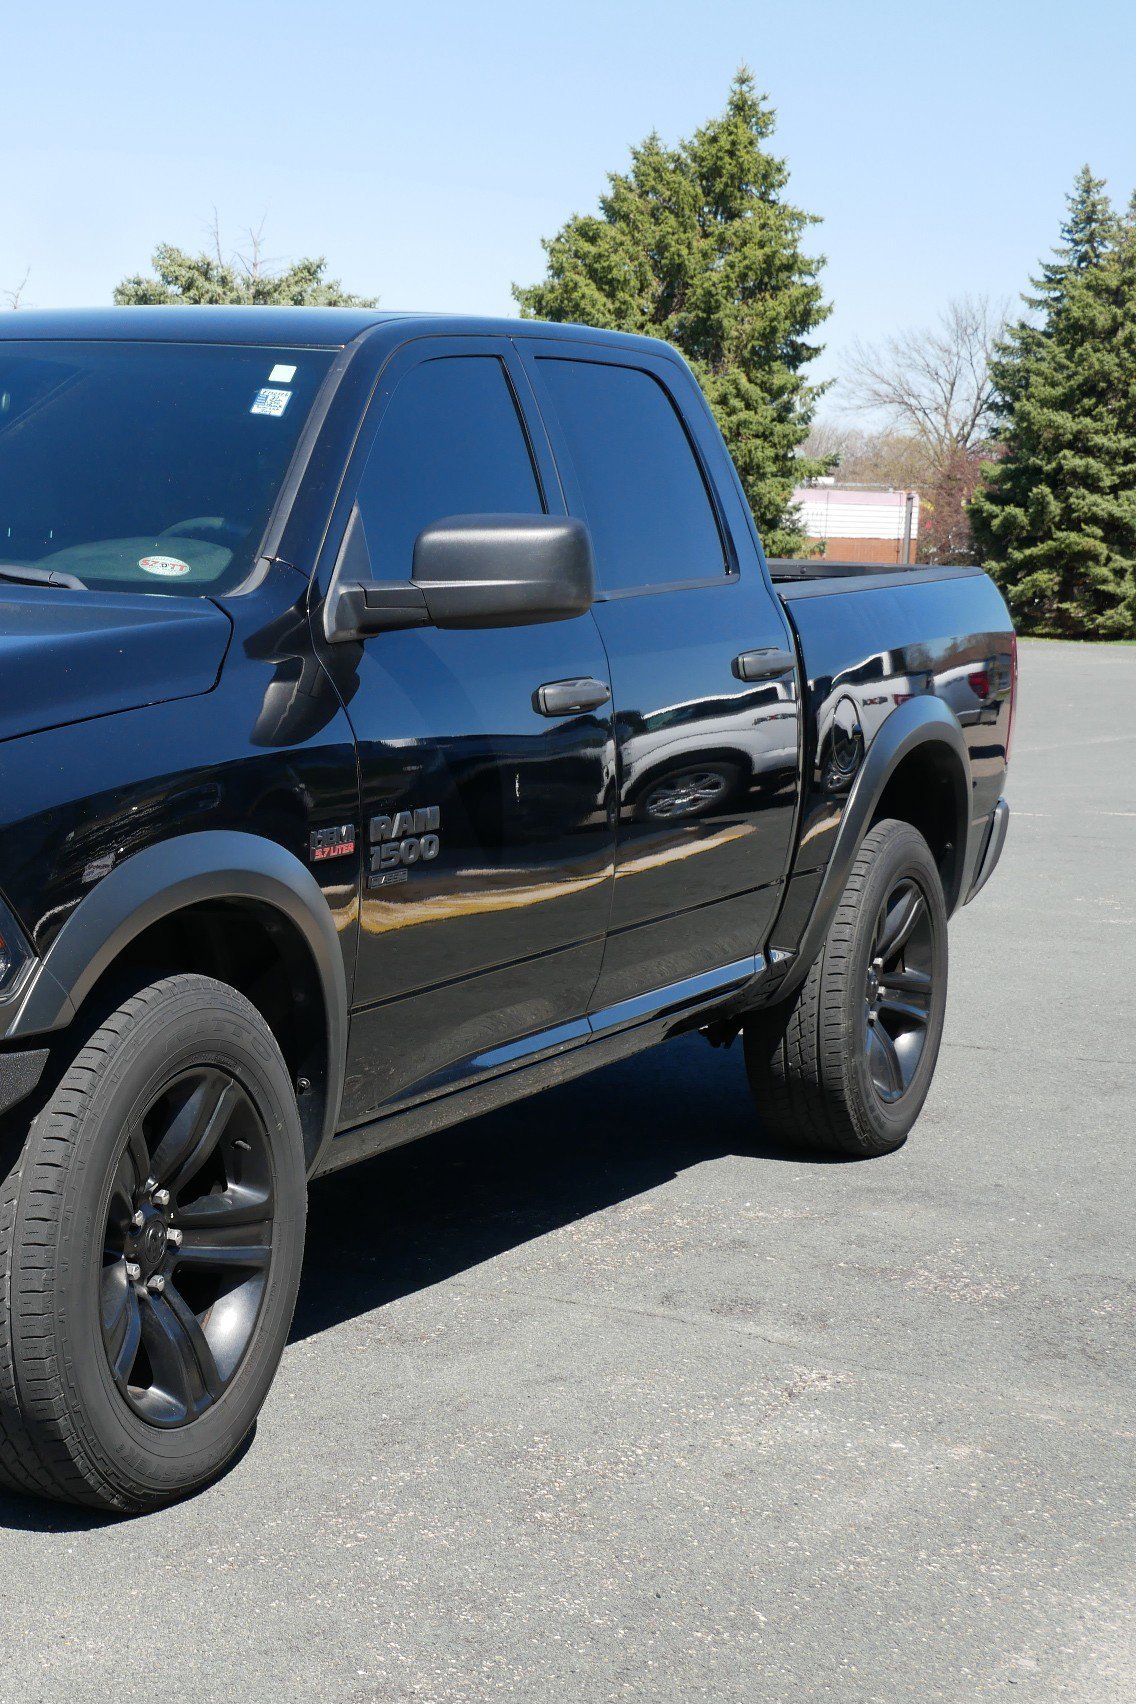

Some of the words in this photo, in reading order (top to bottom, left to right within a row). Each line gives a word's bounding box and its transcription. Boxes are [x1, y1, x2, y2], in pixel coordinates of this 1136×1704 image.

[310, 824, 355, 847] HEMI
[370, 805, 440, 842] RAM
[315, 847, 330, 860] 5.7
[330, 842, 354, 857] LITER
[370, 833, 440, 872] 1500
